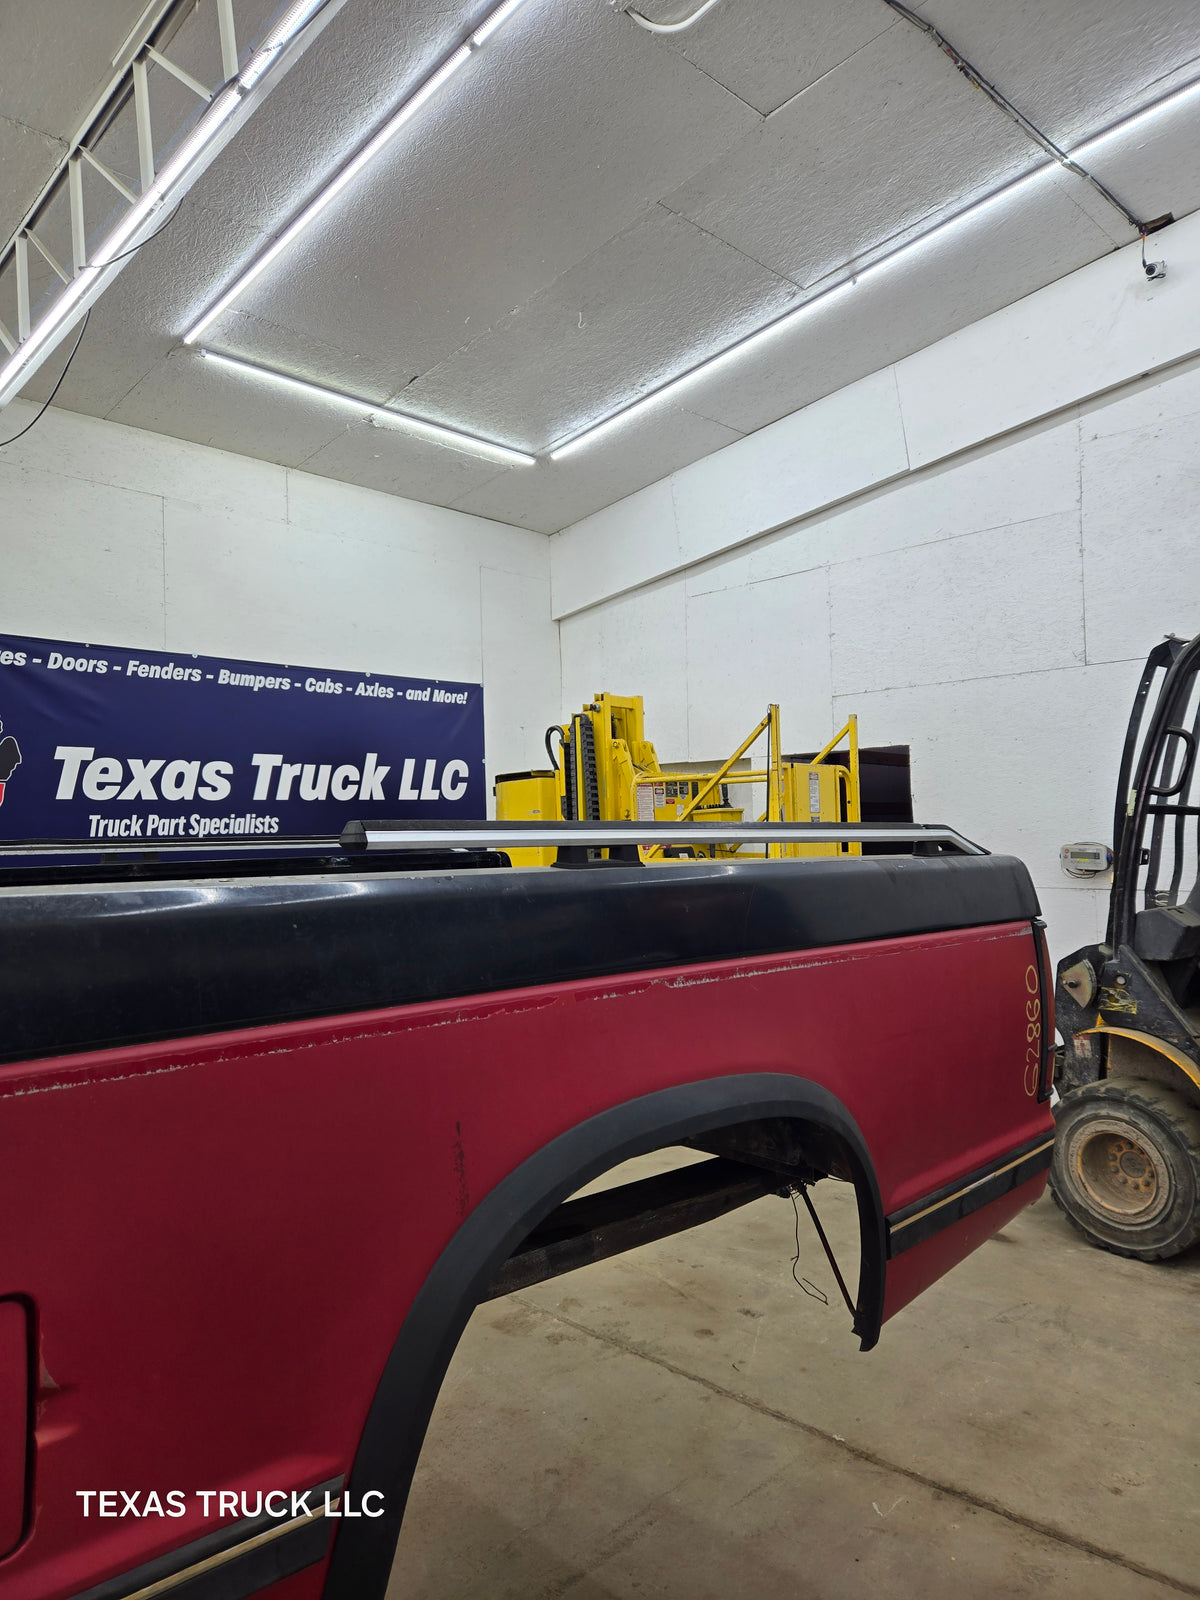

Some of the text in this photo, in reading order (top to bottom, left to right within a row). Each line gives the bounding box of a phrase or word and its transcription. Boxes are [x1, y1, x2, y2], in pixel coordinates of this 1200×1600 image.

[0, 650, 27, 667] es
[47, 652, 109, 674] Doors
[127, 660, 202, 682] Fenders
[218, 668, 291, 692] Bumpers
[305, 678, 344, 695] Cabs
[355, 681, 394, 699] Axles
[406, 687, 432, 702] and
[433, 688, 469, 705] More!
[54, 746, 469, 801] Texas Truck LLC
[89, 813, 280, 838] Truck Part Specialists
